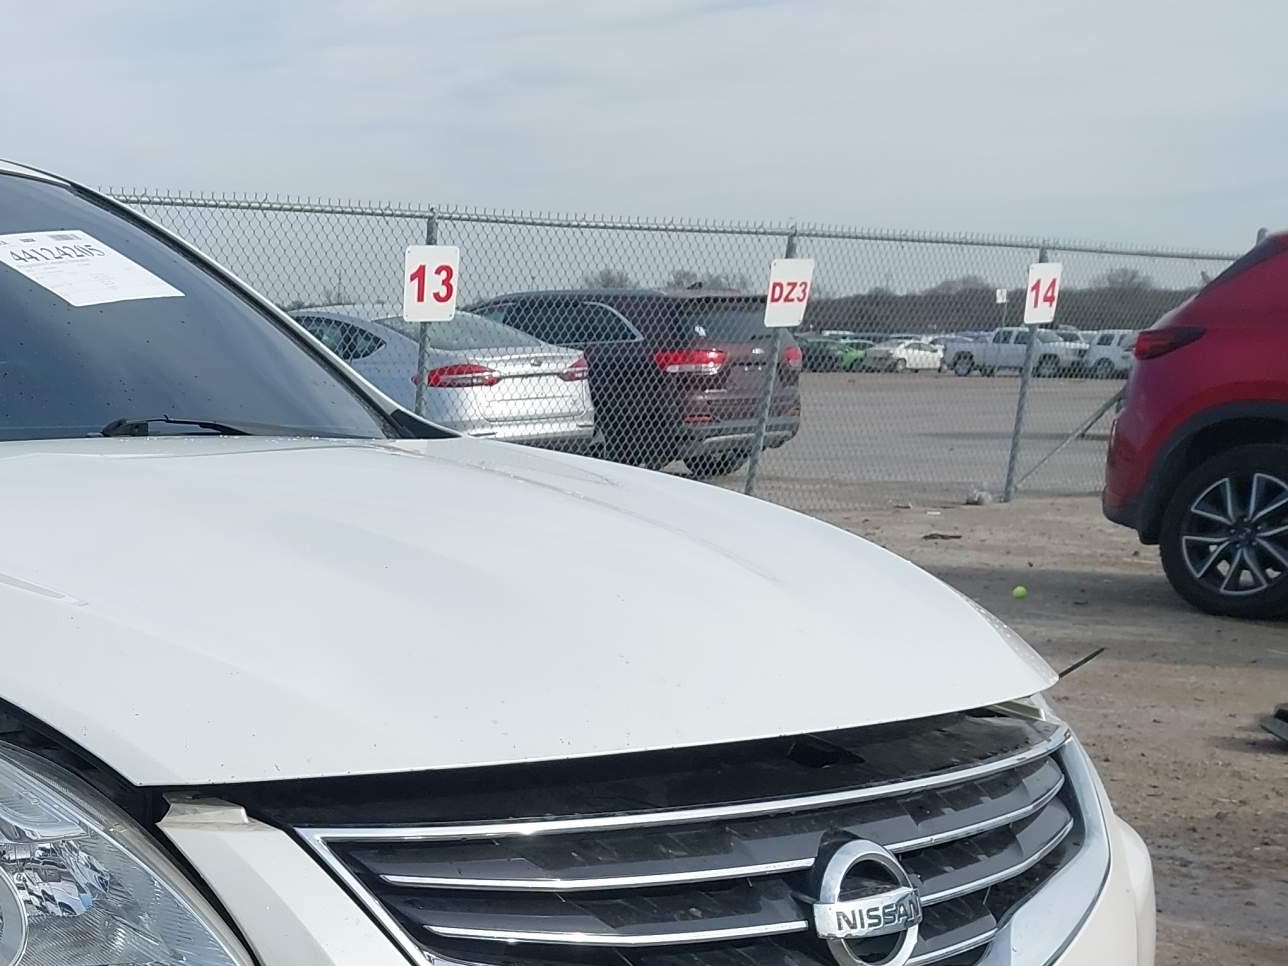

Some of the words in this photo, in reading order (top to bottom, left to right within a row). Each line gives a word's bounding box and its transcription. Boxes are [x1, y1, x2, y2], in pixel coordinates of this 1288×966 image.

[10, 244, 105, 262] 44124205
[410, 264, 454, 303] 13
[770, 281, 808, 303] DZ3
[1030, 278, 1057, 308] 14
[836, 899, 920, 931] NISSAN
